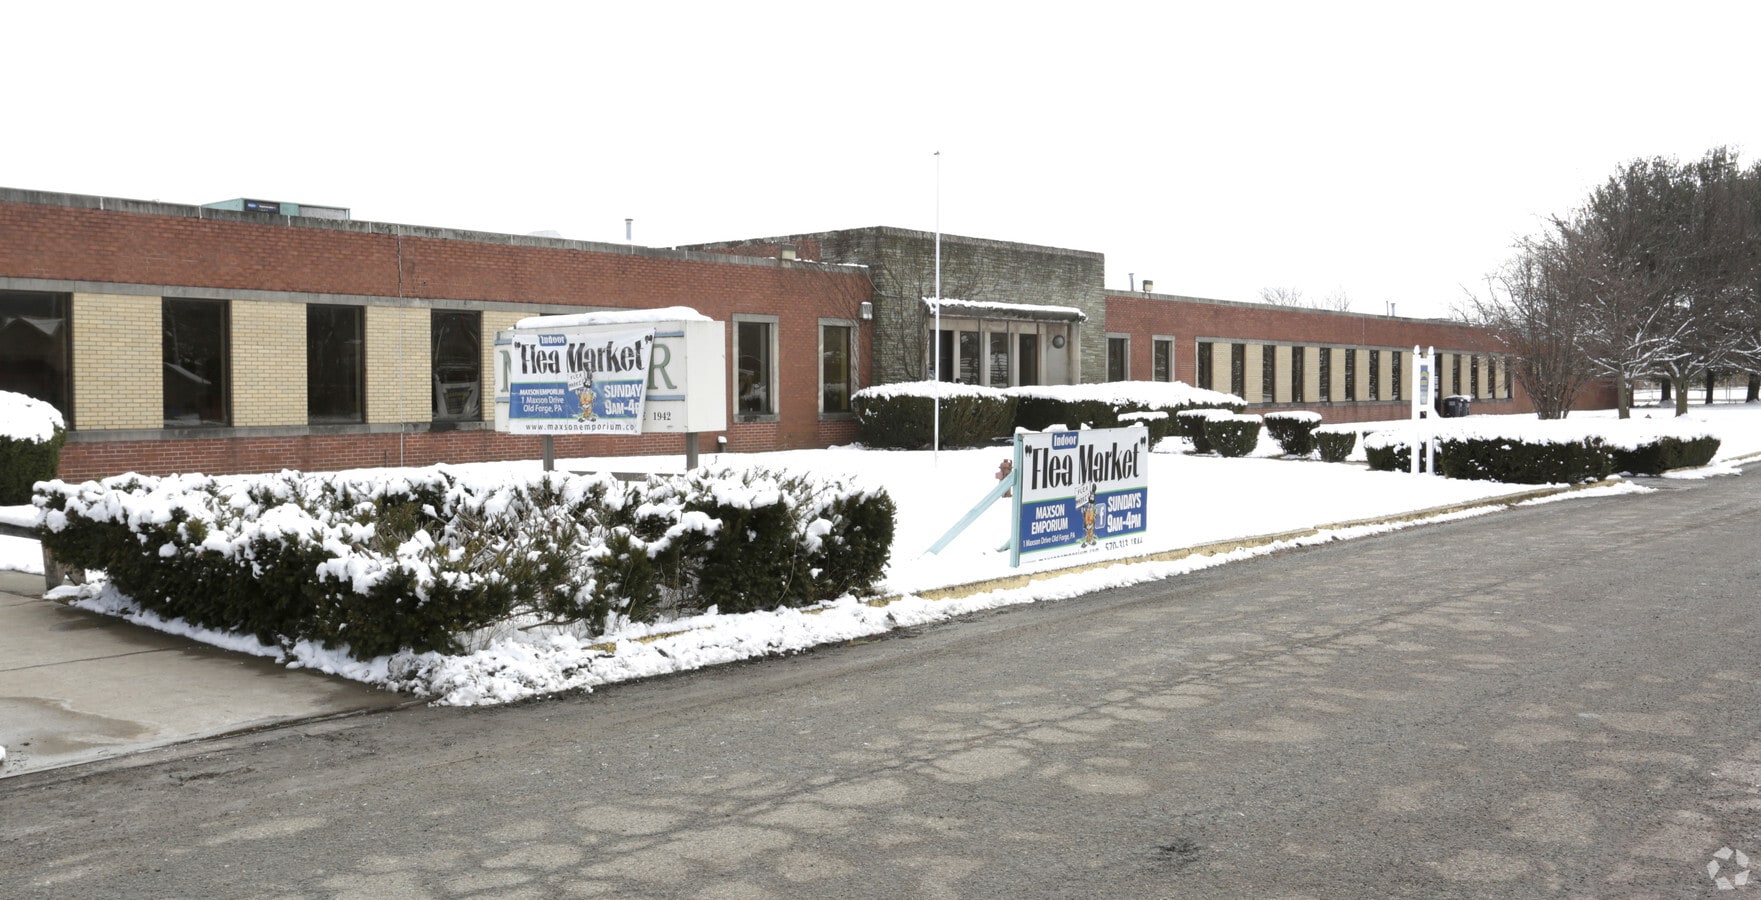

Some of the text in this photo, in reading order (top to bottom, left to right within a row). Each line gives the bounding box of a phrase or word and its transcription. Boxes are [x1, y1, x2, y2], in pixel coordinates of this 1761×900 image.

[541, 335, 565, 344] Indoor
[521, 396, 525, 404] 1
[604, 399, 640, 415] 9AM-4P
[653, 411, 671, 420] 1942
[525, 424, 636, 432] www.maxsonemporium.co
[1053, 434, 1078, 447] Indoor
[1107, 492, 1142, 512] SUNDAYS
[1035, 504, 1065, 520] MAXSON
[1031, 517, 1069, 535] EMPORIUM
[1107, 511, 1142, 533] 9AM-4PM
